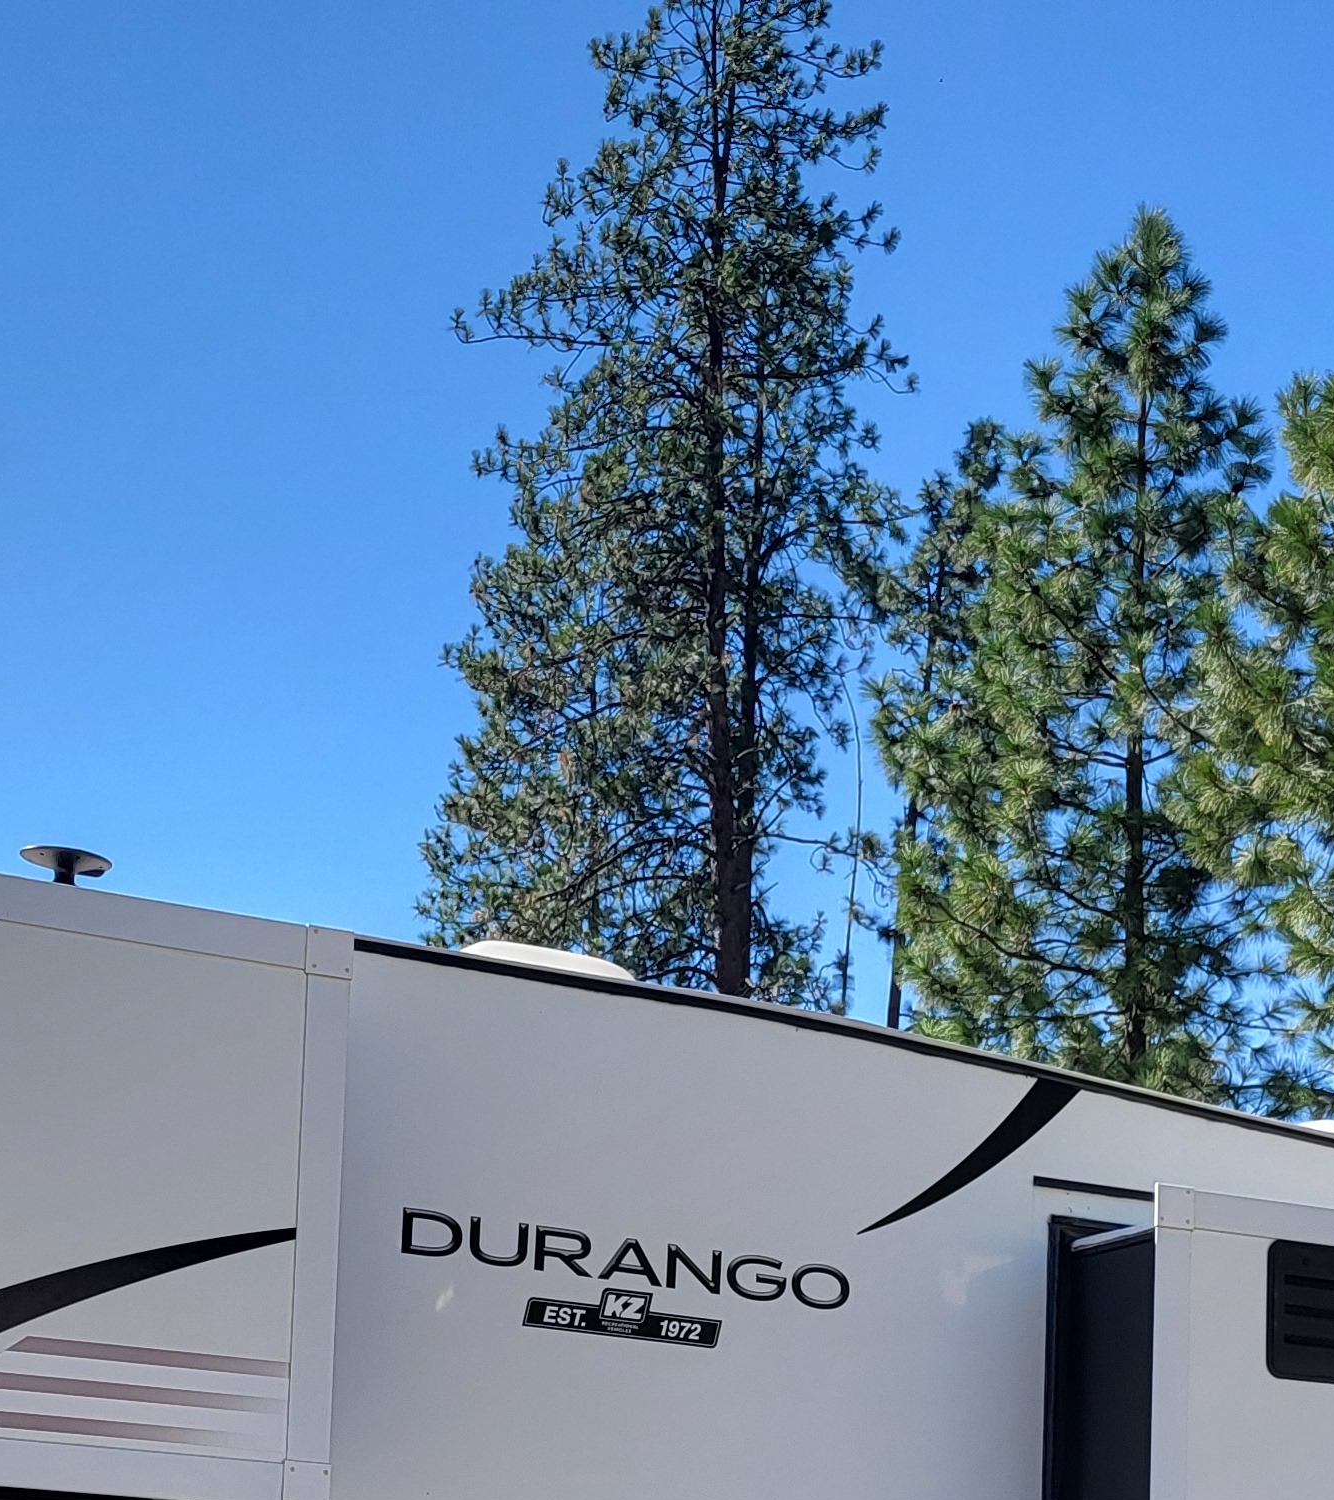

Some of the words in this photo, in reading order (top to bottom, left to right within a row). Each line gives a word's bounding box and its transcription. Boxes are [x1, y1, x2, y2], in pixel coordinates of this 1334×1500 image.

[400, 1206, 851, 1310] DURANGO
[542, 1305, 587, 1327] EST.
[659, 1319, 702, 1341] 1972
[603, 1294, 646, 1320] KZ
